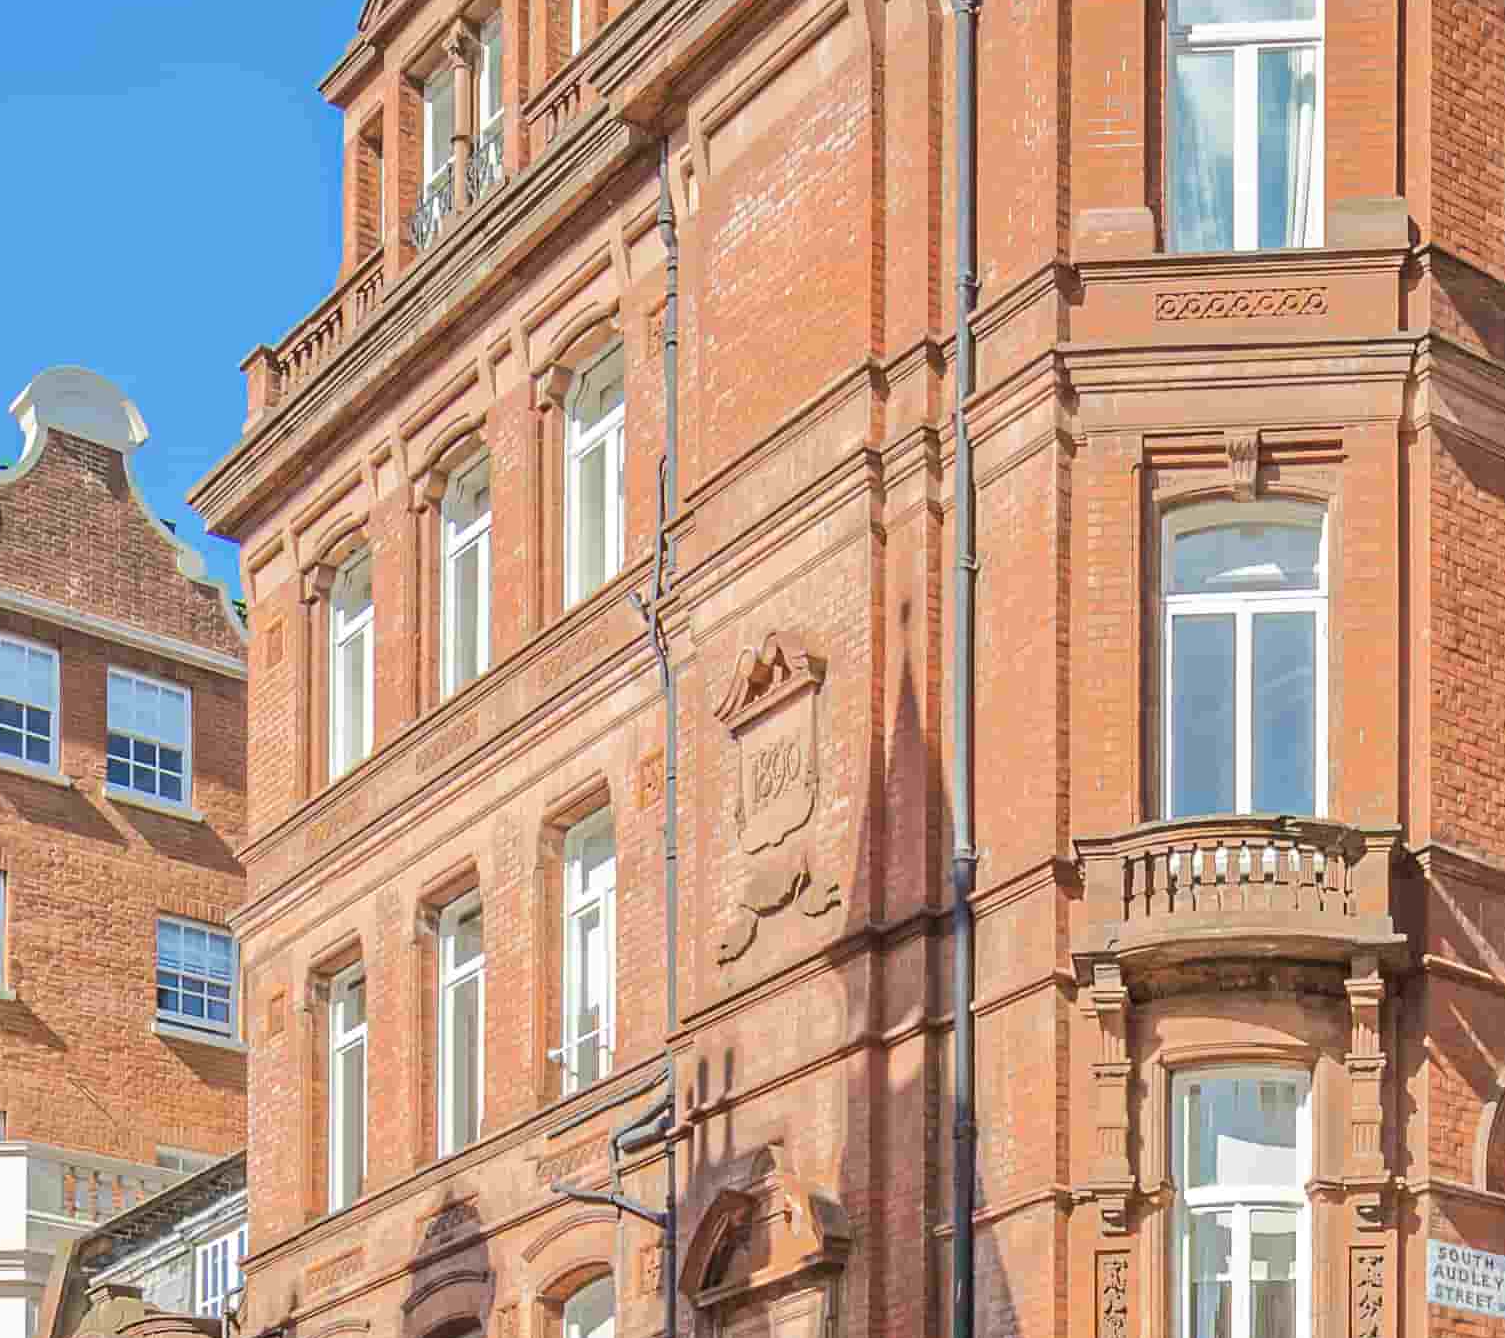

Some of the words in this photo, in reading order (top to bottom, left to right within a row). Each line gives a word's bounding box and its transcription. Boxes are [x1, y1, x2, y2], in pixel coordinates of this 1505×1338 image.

[1438, 1246, 1495, 1270] SOUTH
[1433, 1265, 1505, 1289] AUDLEY
[1435, 1286, 1493, 1308] STREET
